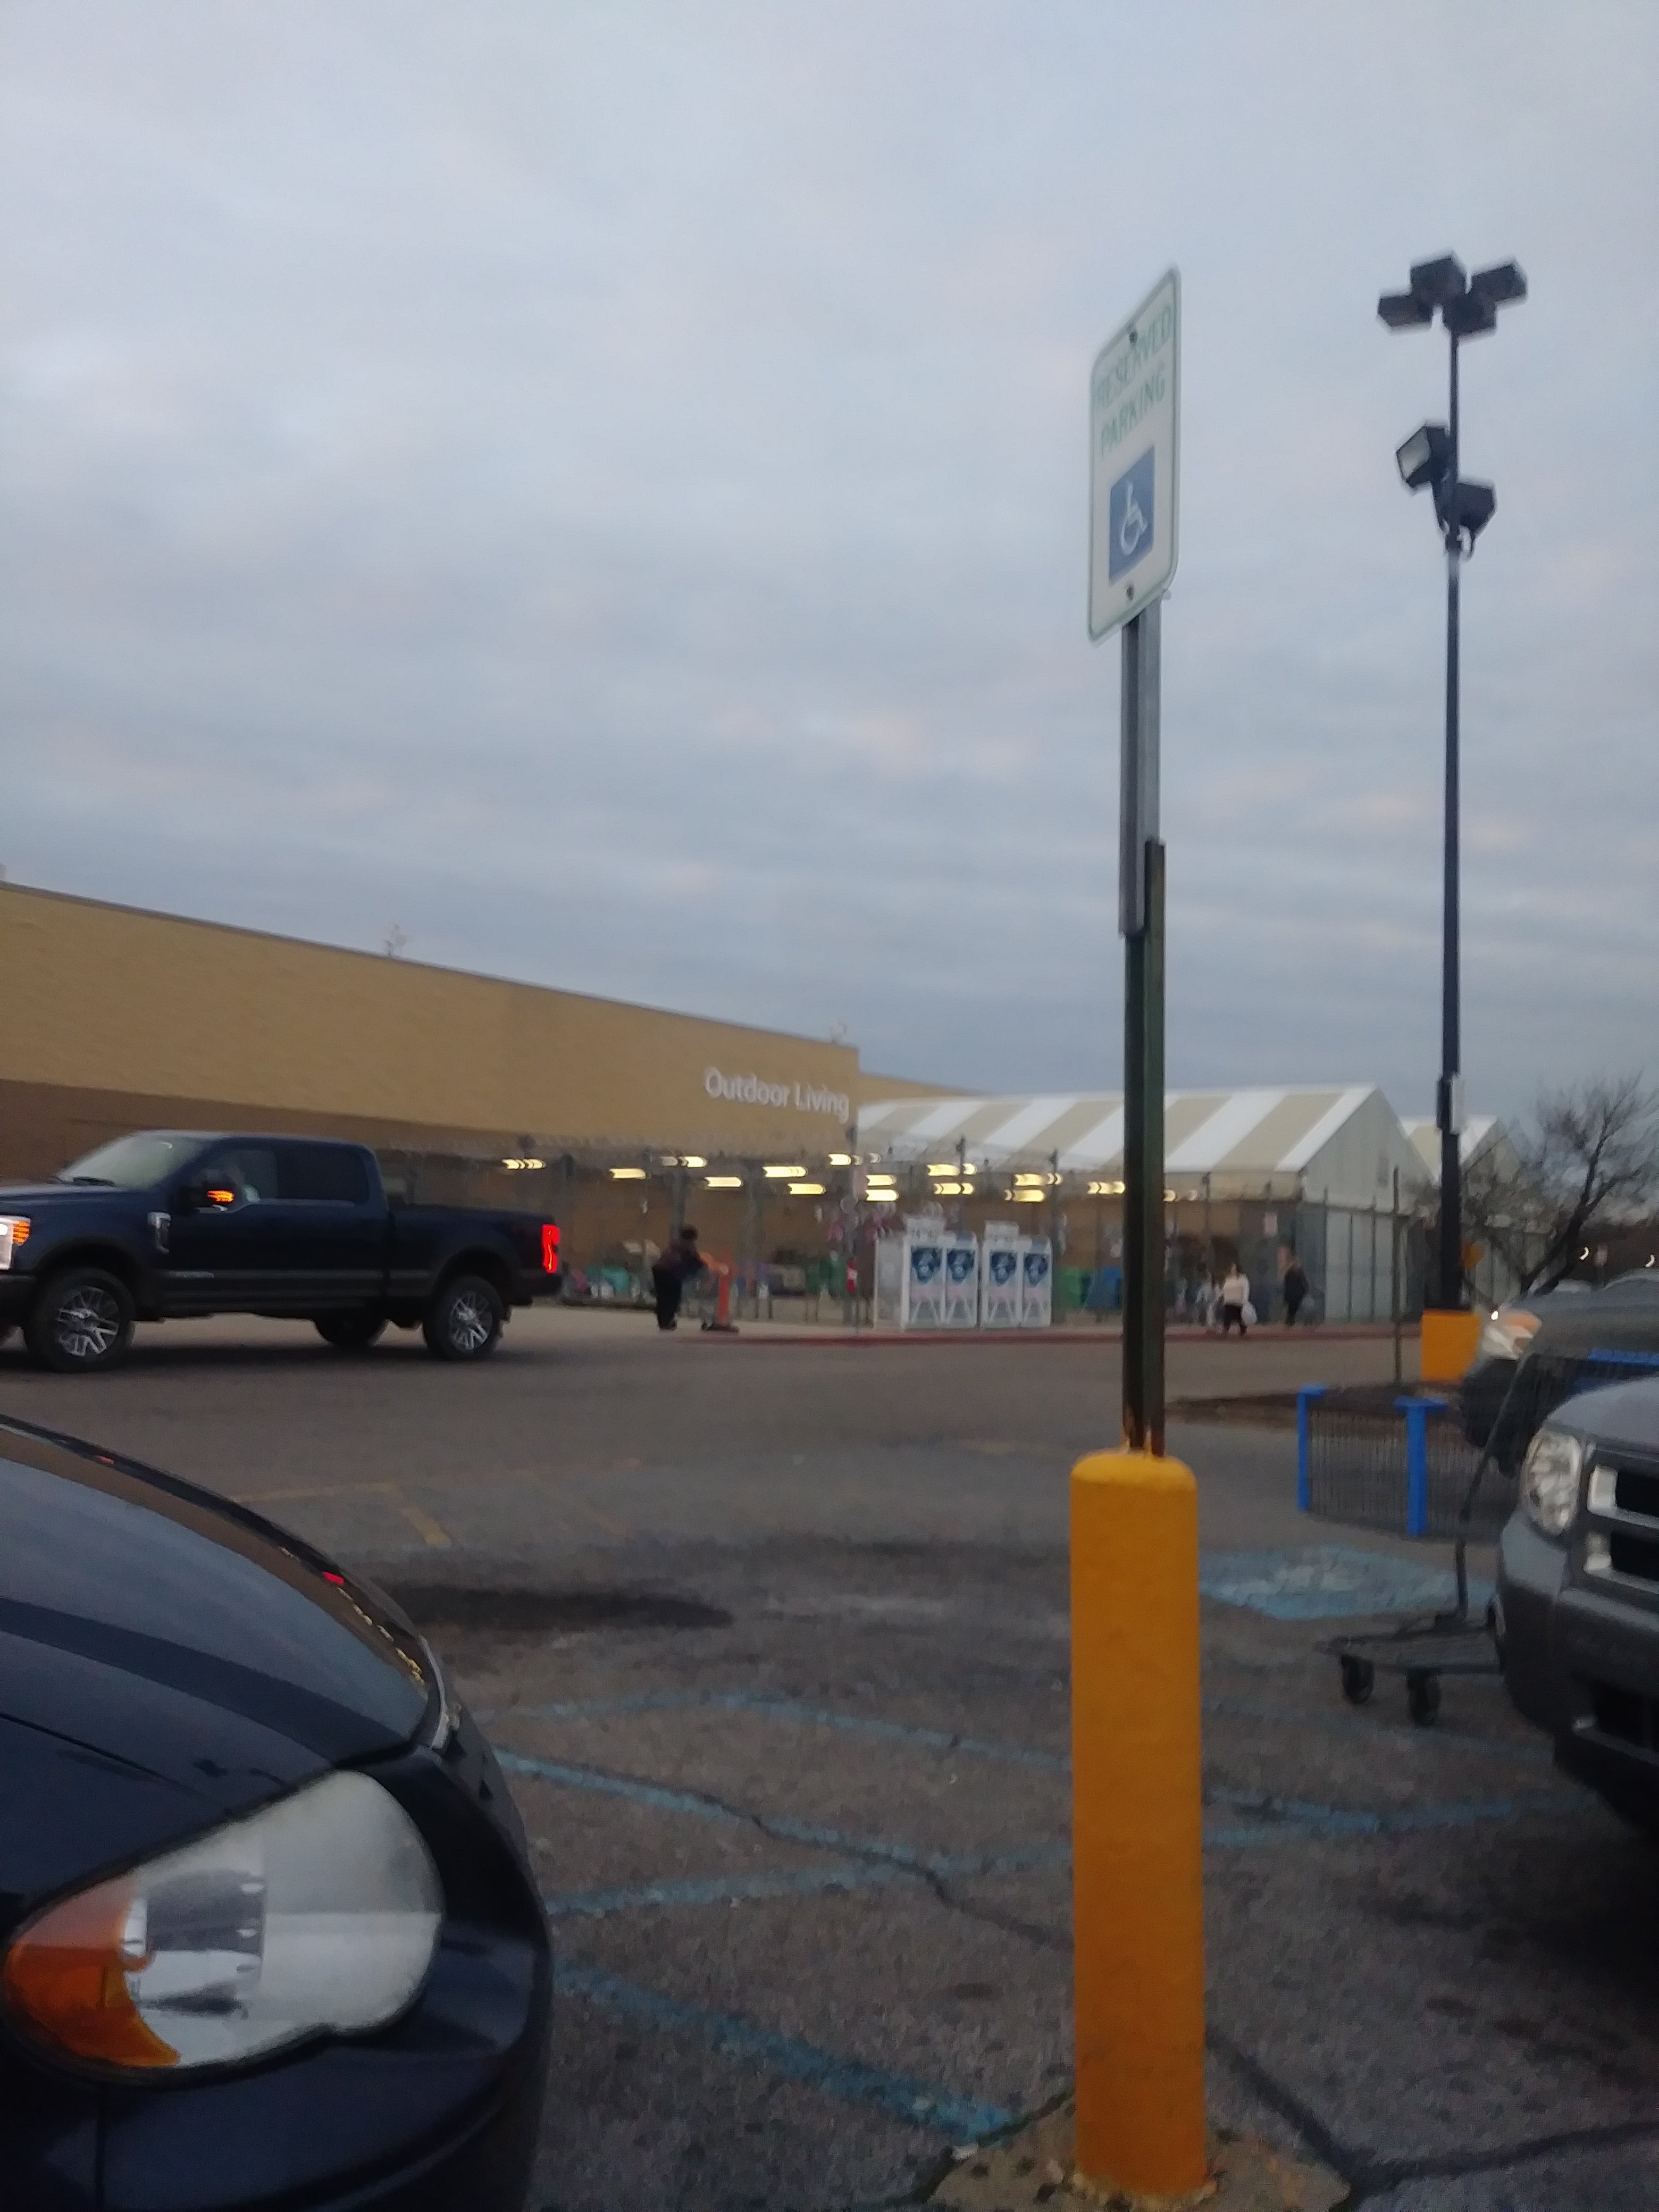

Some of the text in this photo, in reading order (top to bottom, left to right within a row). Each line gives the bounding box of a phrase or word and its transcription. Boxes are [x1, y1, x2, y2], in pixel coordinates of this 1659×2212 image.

[1100, 360, 1165, 459] PARKING
[704, 1066, 850, 1124] Outdoor Living
